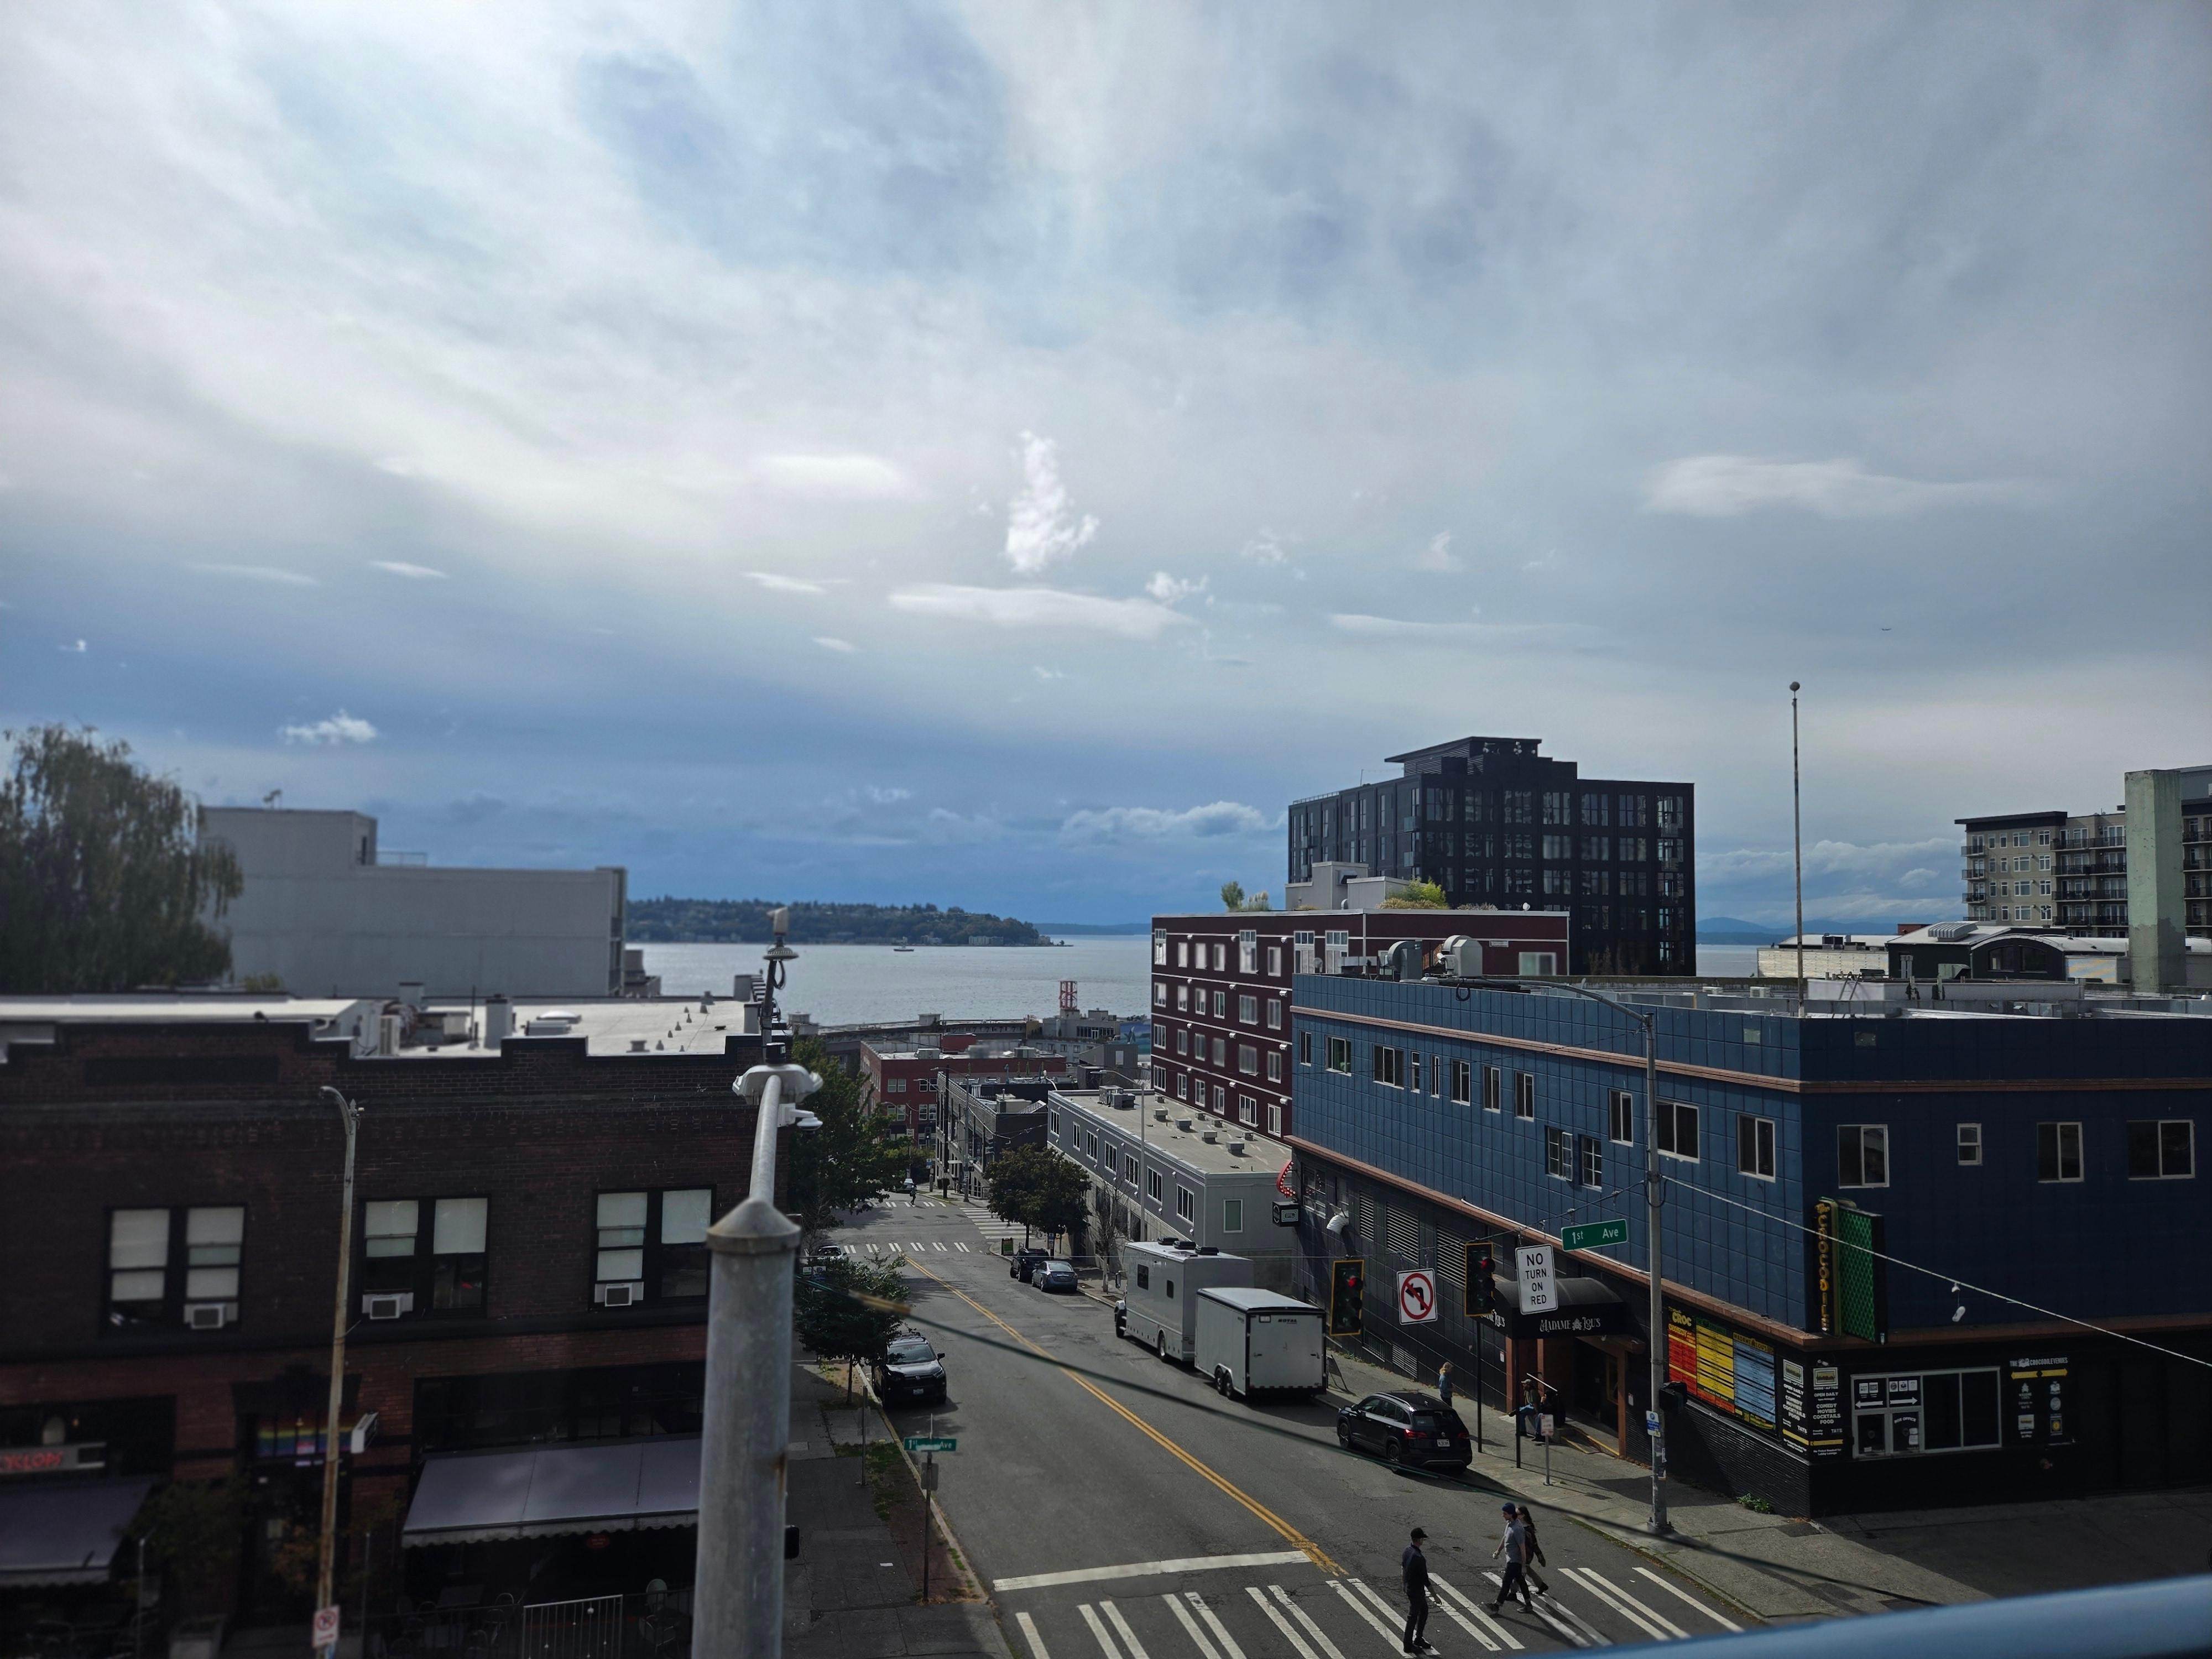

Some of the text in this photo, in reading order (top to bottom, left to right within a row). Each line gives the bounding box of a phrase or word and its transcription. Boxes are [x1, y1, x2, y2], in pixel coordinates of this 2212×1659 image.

[1572, 1228, 1619, 1244] 1st Ave
[1527, 1253, 1543, 1266] NO
[1525, 1269, 1547, 1280] TURN
[1532, 1282, 1543, 1291] ON
[1531, 1295, 1546, 1305] RED
[1672, 1311, 1692, 1327] CROC
[1540, 1318, 1571, 1332] MADAME
[1788, 1411, 1801, 1421] FOOD
[908, 1439, 953, 1449] 1st Ave
